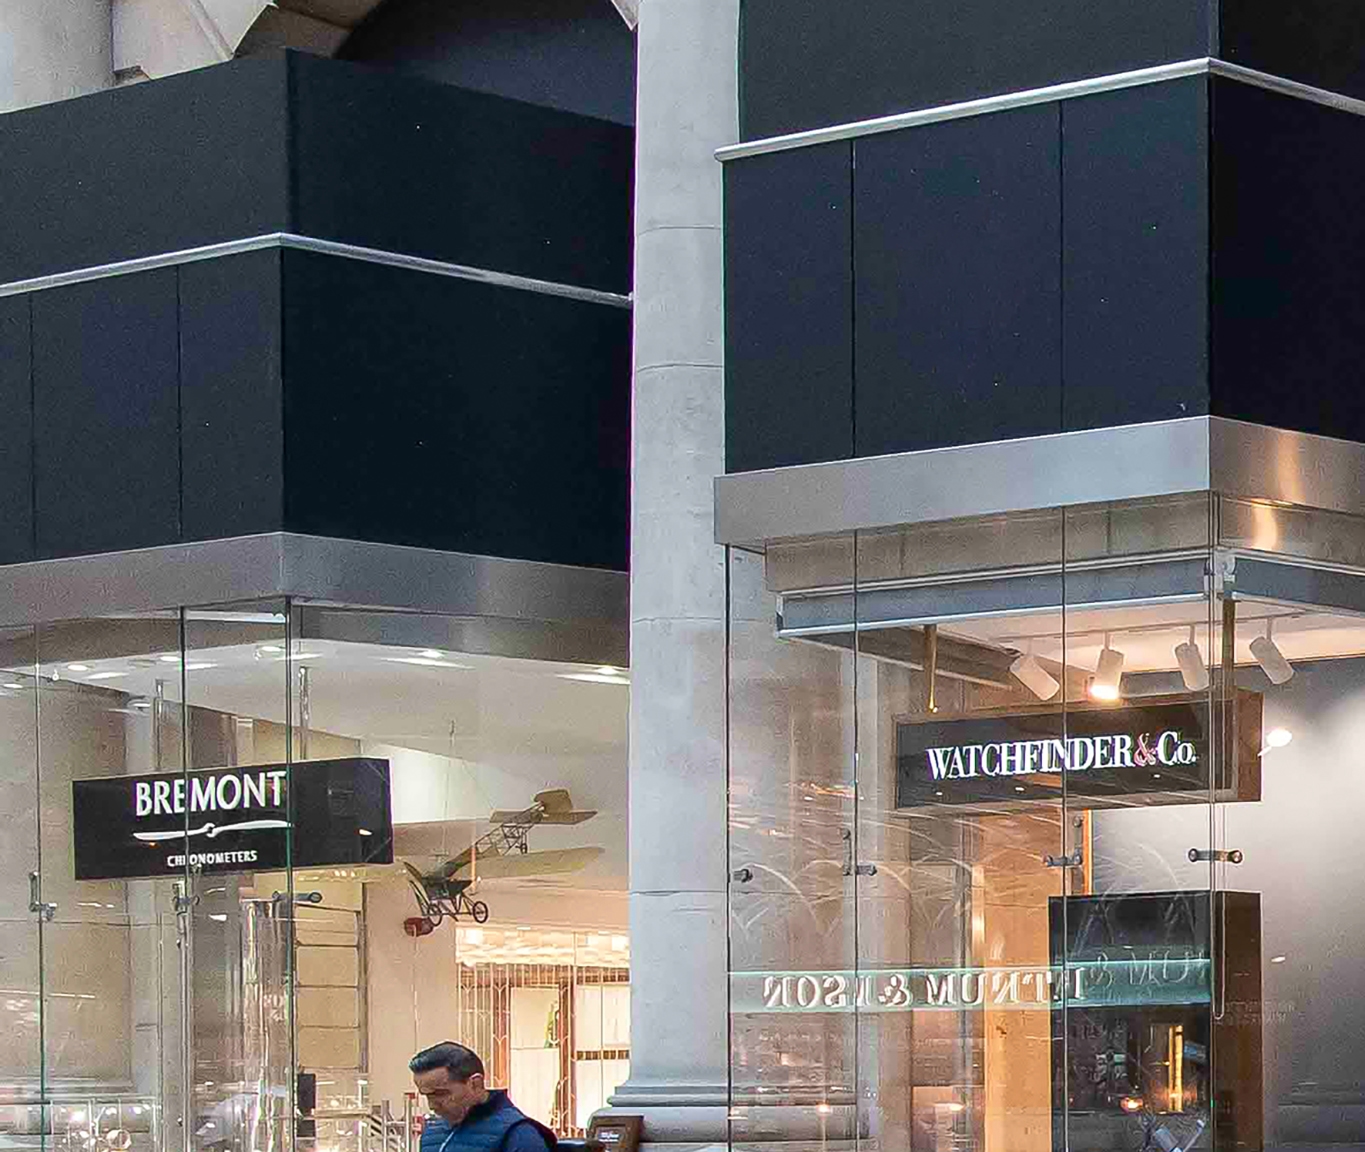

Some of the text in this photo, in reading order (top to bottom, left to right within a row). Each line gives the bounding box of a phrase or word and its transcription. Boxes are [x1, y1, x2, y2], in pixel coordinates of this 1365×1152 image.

[926, 731, 1197, 780] WATCHFINDER&Co.
[136, 771, 287, 816] BREMONT
[167, 850, 258, 867] CHONOMETERS
